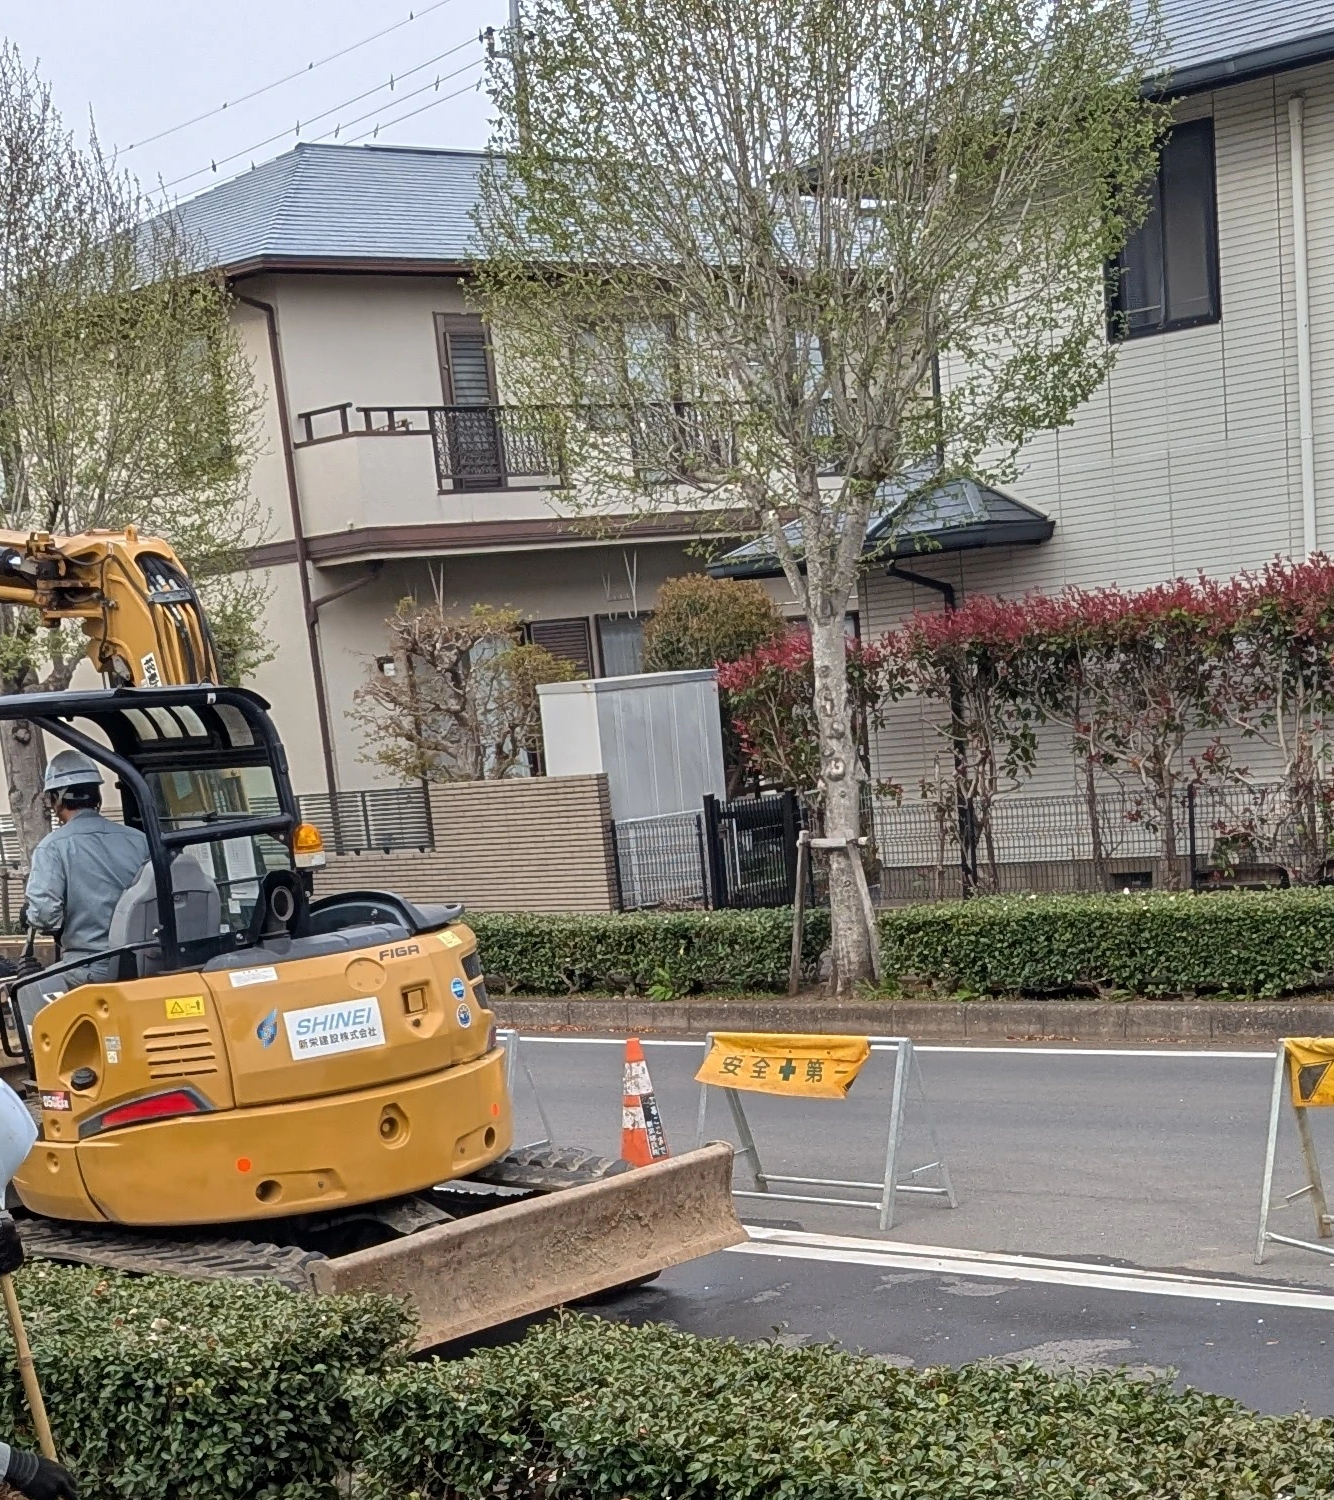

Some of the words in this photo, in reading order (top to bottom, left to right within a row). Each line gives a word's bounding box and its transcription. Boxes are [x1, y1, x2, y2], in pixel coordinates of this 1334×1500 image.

[296, 1007, 372, 1036] SHINEI
[298, 1027, 378, 1049] 新栄建設株式会社
